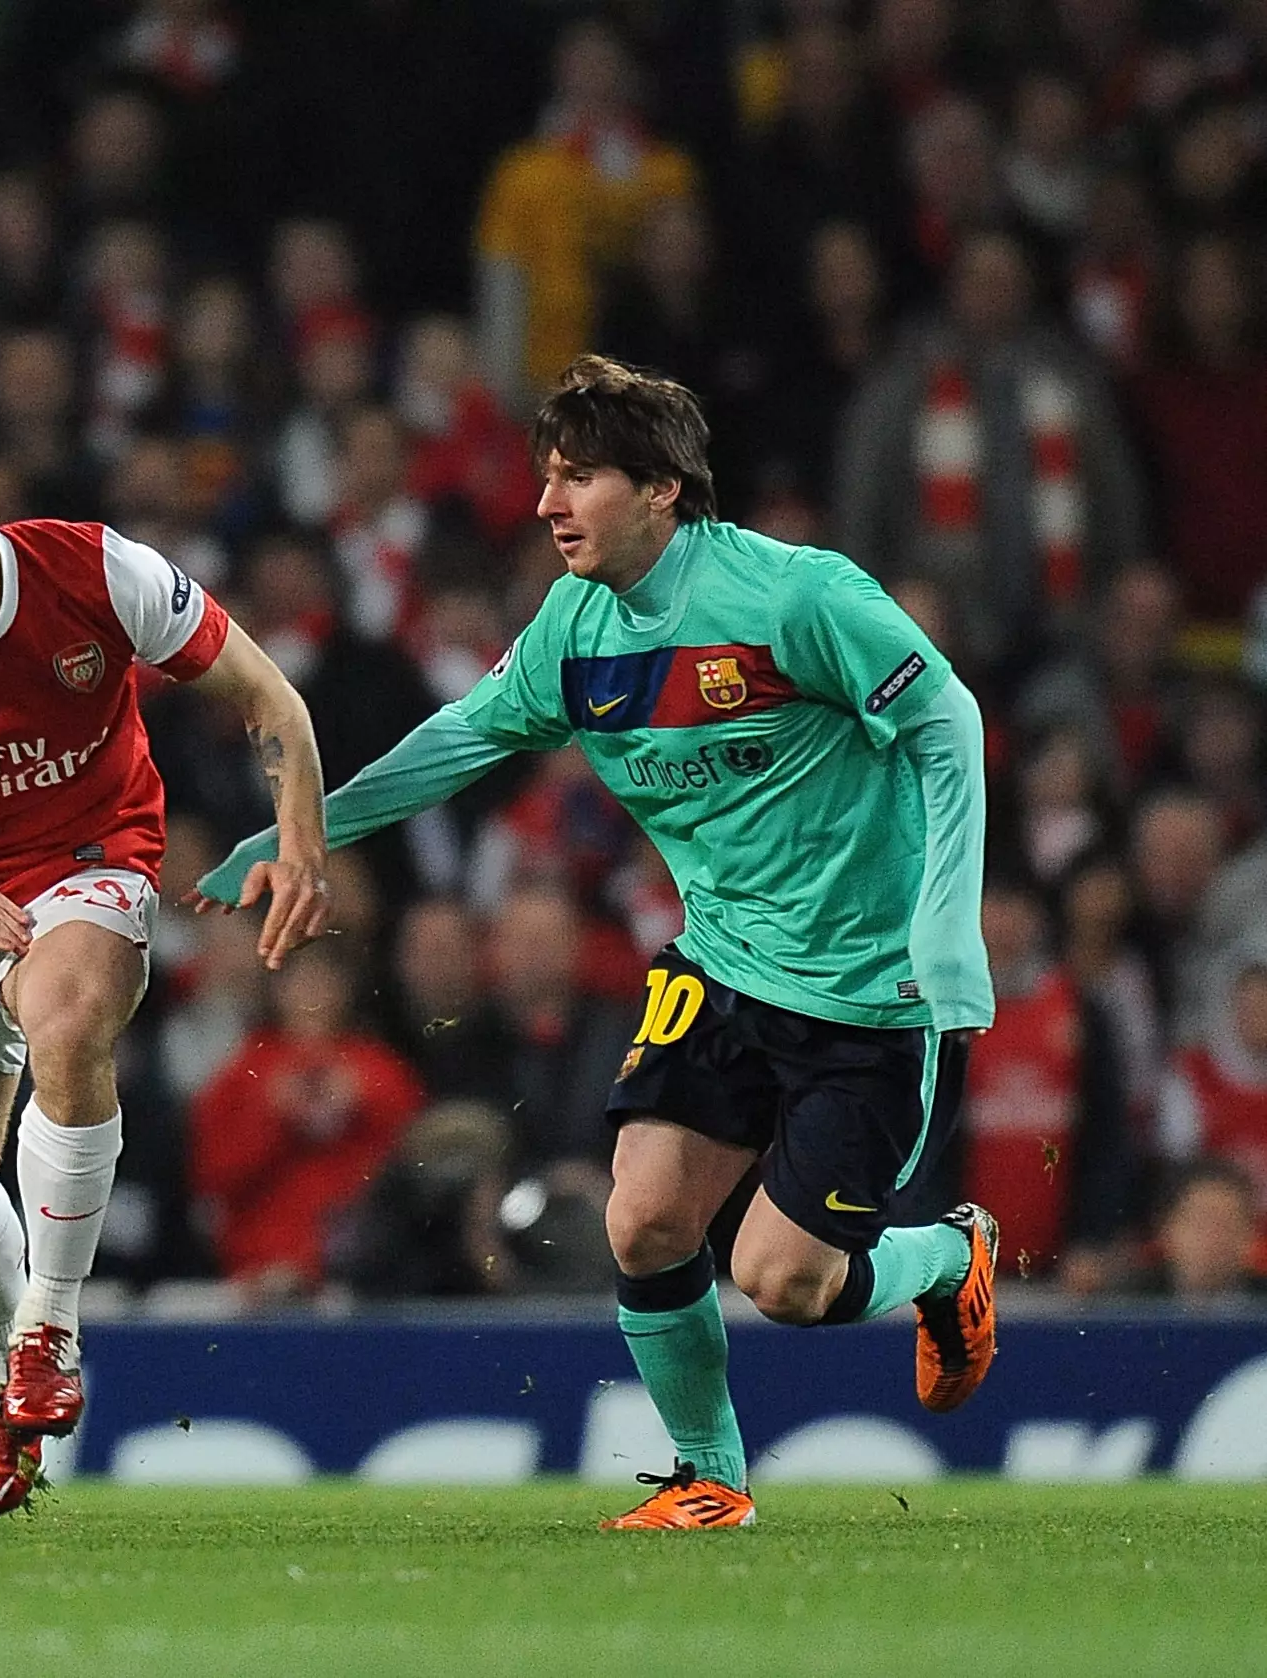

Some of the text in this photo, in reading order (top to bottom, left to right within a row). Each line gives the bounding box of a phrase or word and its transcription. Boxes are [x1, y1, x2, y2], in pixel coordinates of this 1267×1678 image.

[881, 656, 922, 699] RESPECT
[624, 745, 721, 790] unicef
[632, 969, 705, 1045] 10
